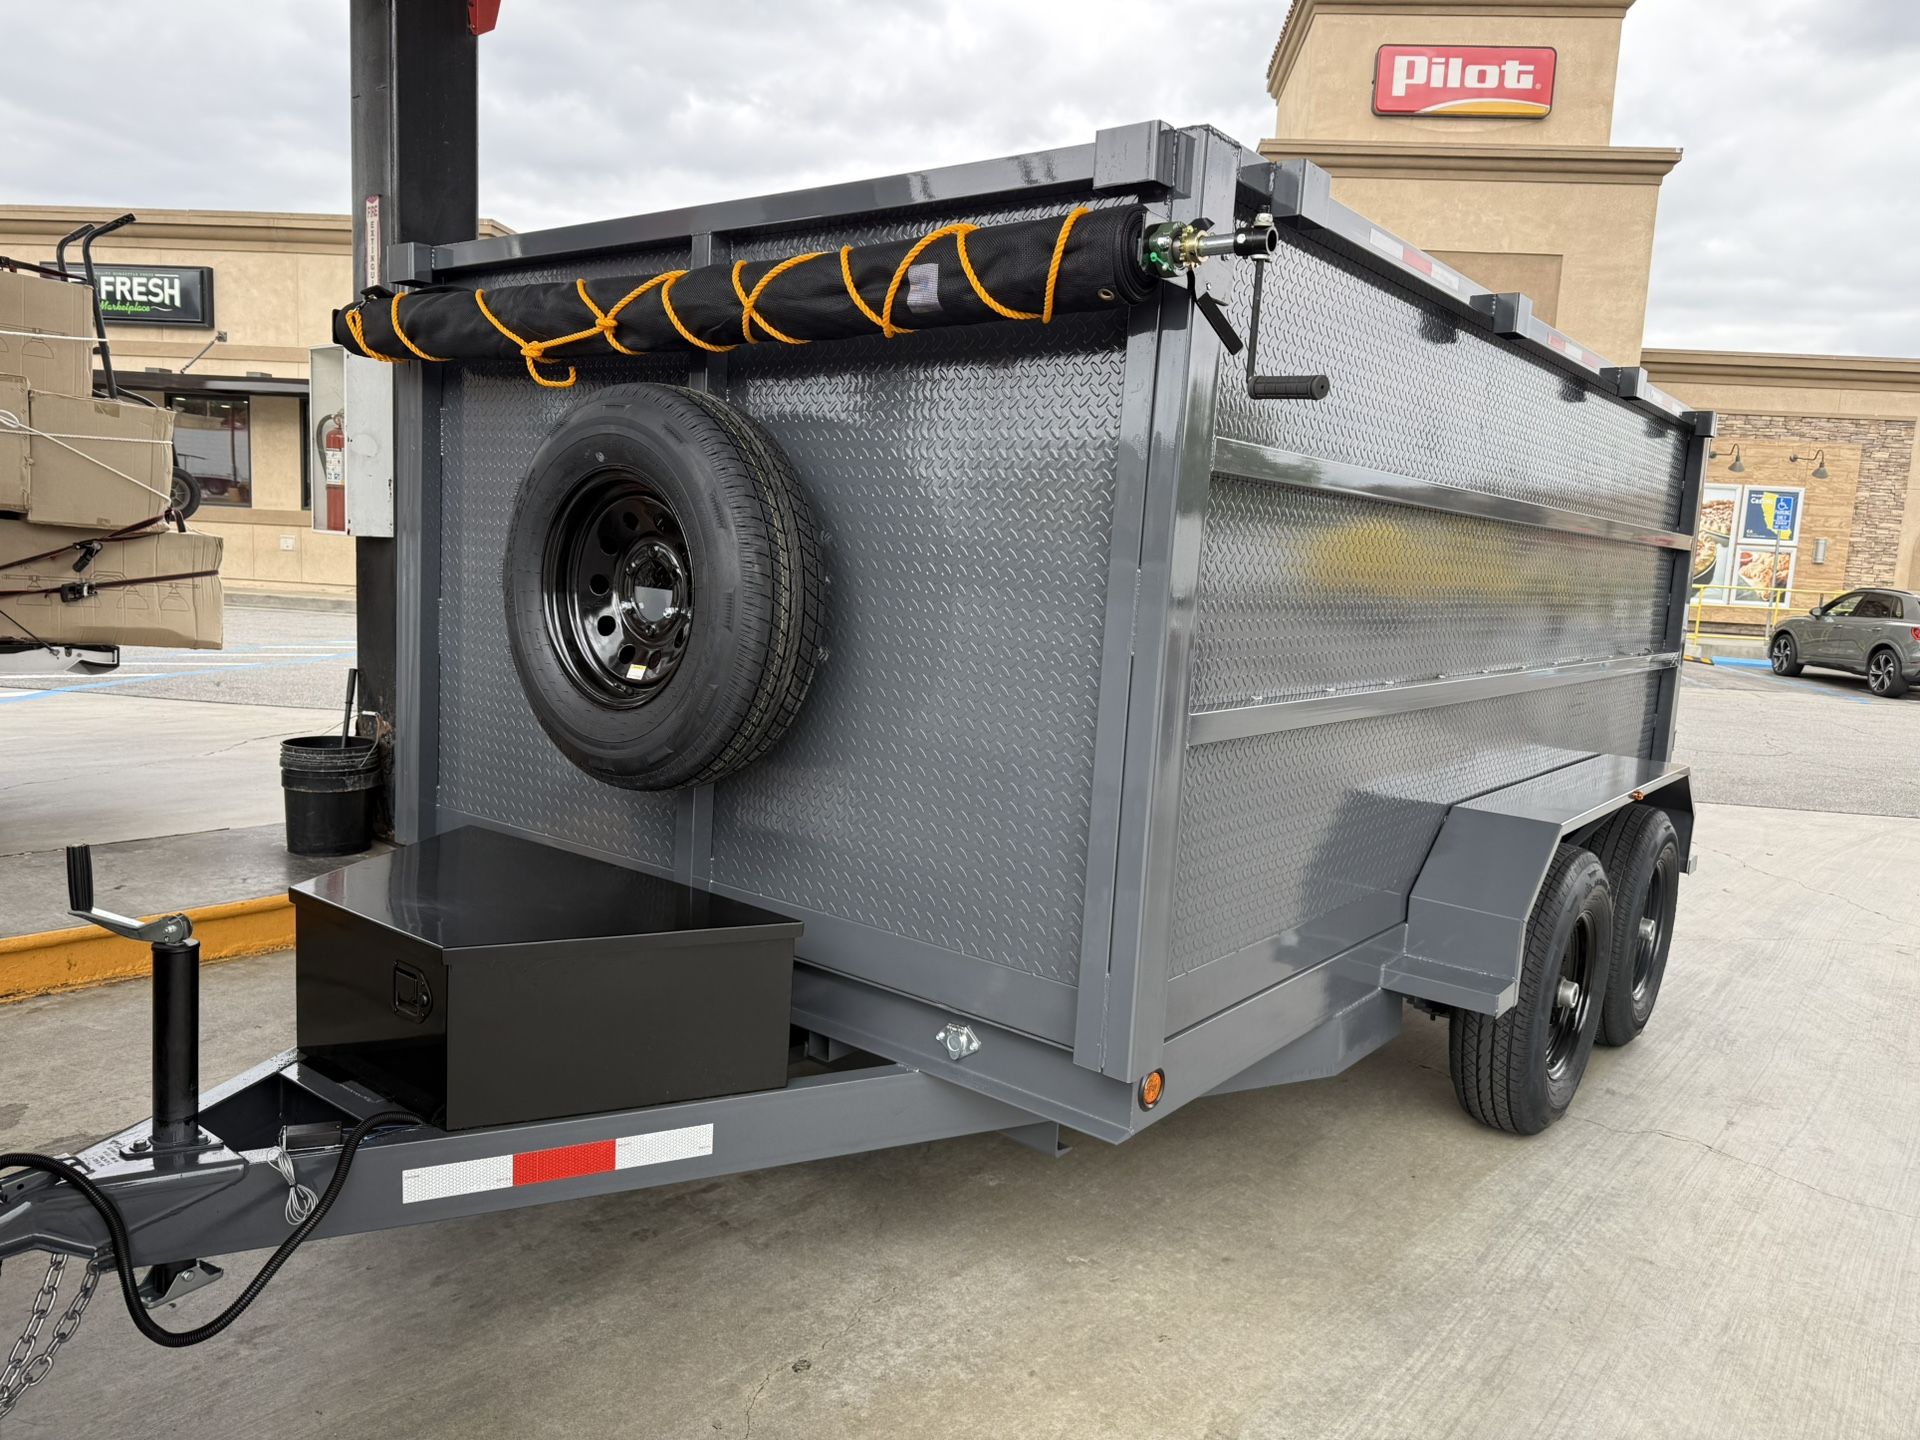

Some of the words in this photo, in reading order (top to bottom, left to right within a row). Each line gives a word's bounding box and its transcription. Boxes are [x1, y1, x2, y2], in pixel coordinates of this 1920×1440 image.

[1391, 55, 1535, 96] Pilot
[100, 276, 181, 308] FRESH
[100, 301, 150, 314] Marketplace
